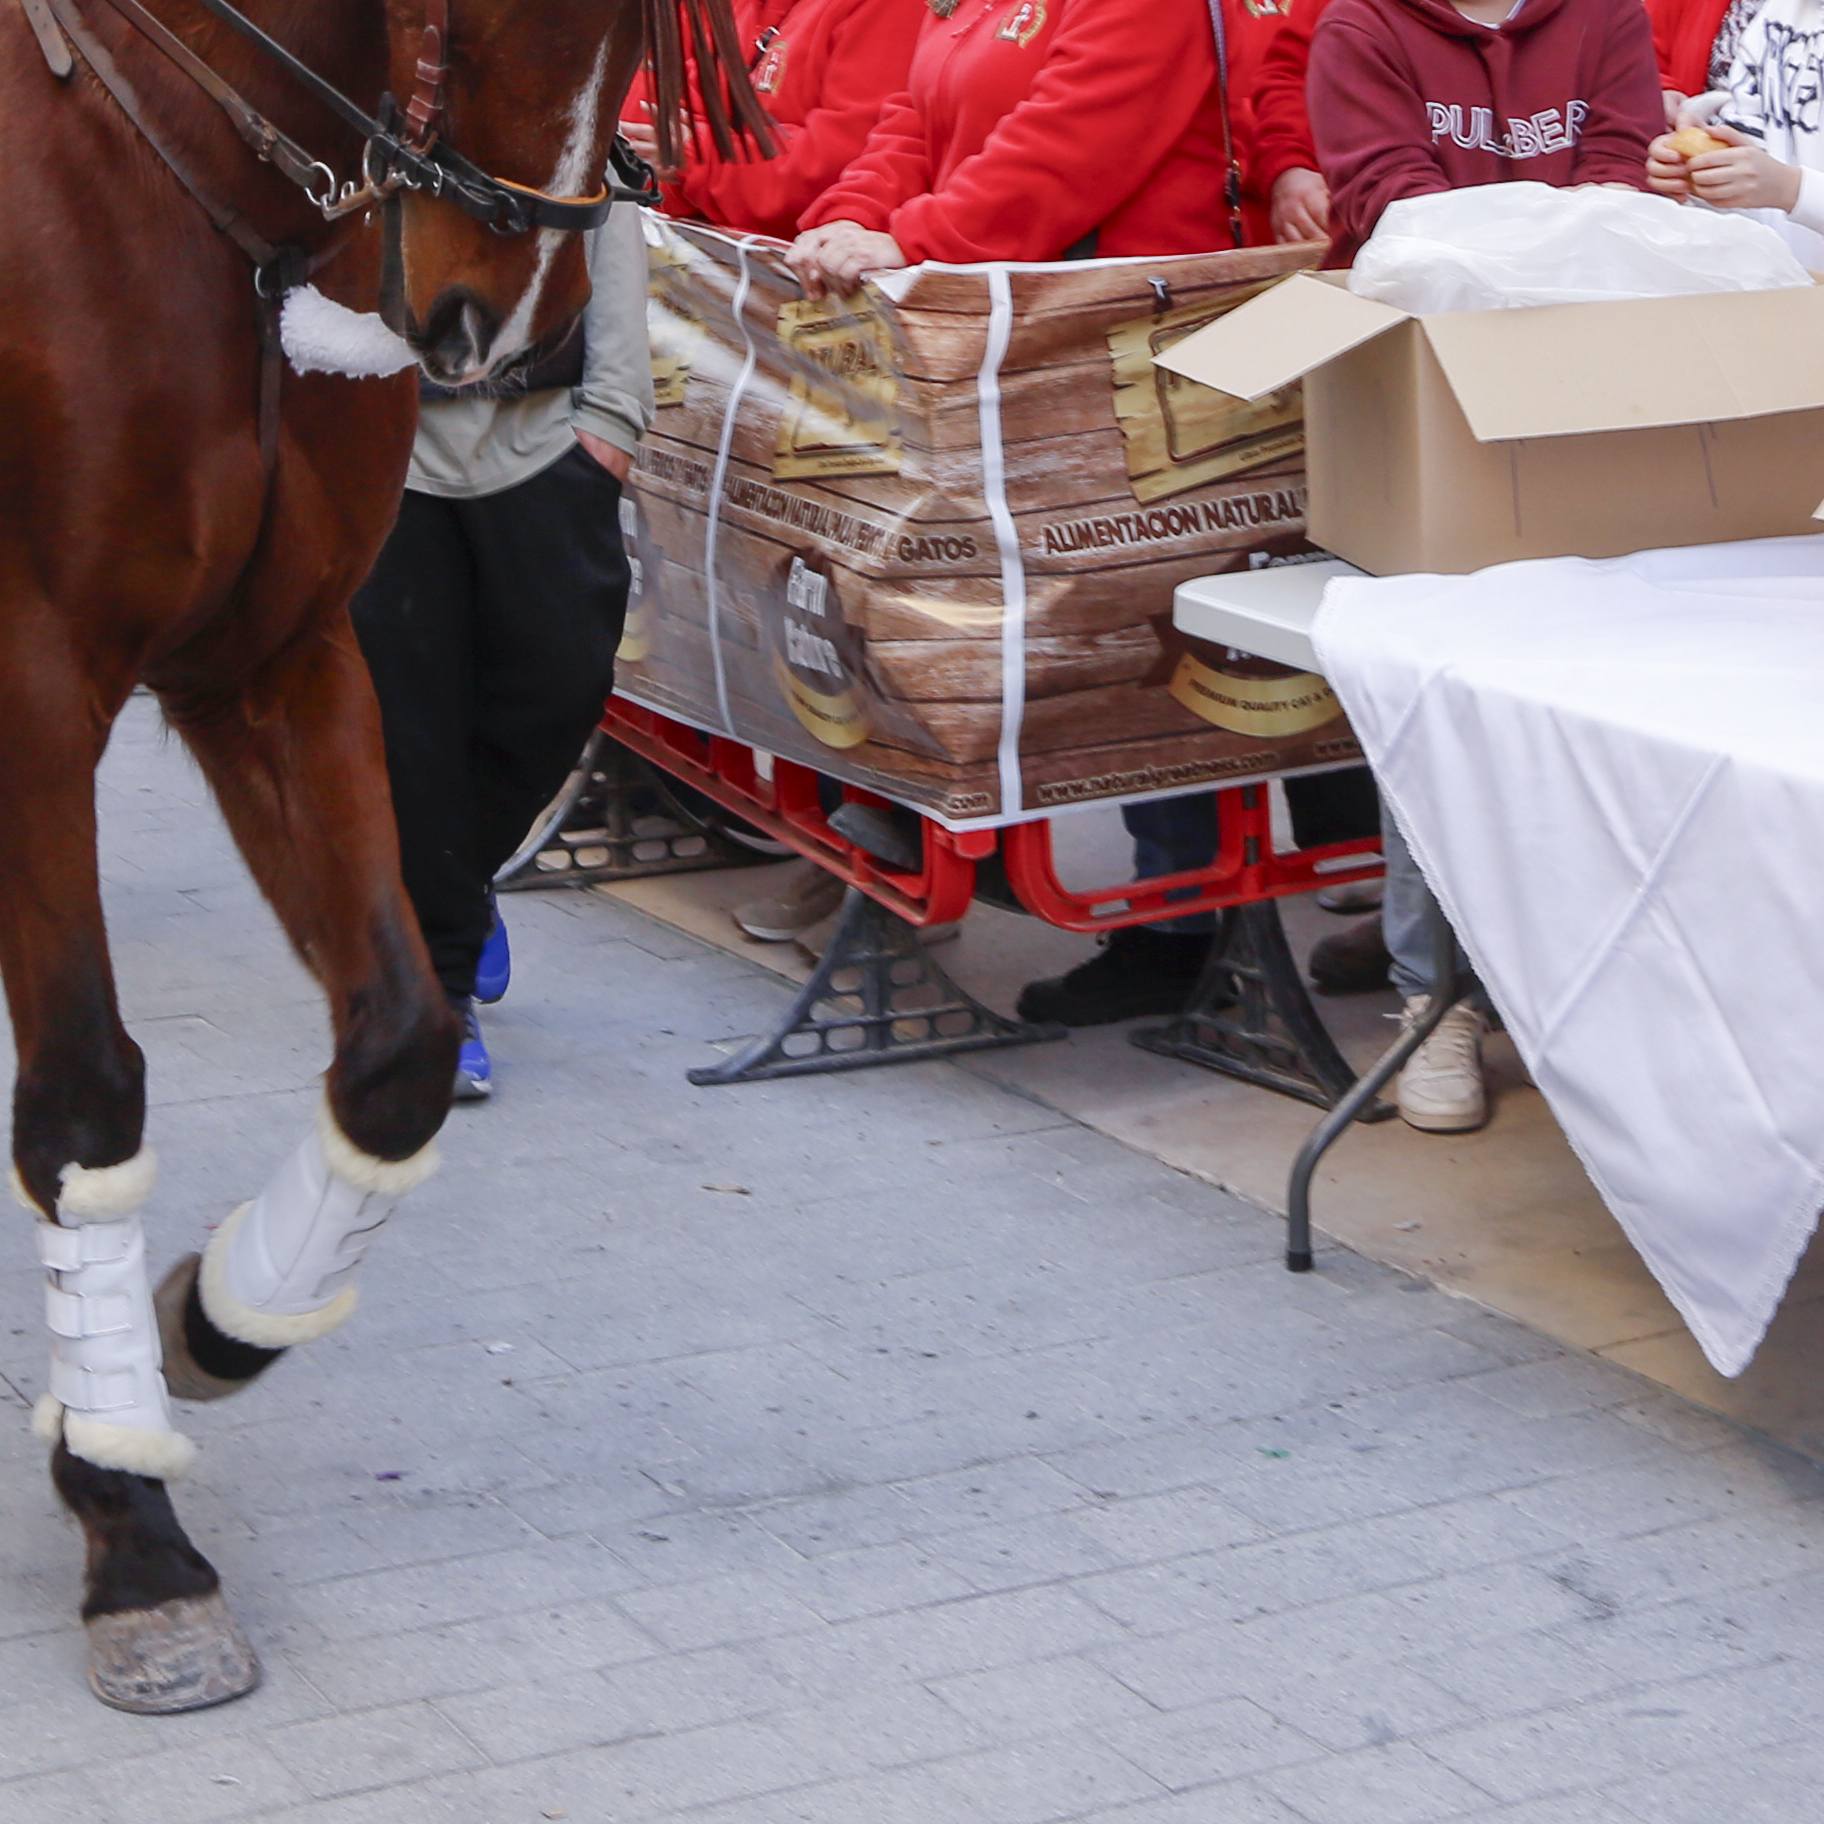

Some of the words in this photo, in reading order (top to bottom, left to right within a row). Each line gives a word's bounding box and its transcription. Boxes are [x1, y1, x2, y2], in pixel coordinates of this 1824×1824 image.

[1044, 504, 1201, 555] ALIMENTACION
[1203, 491, 1302, 527] NATURAL
[898, 535, 976, 563] GATOS
